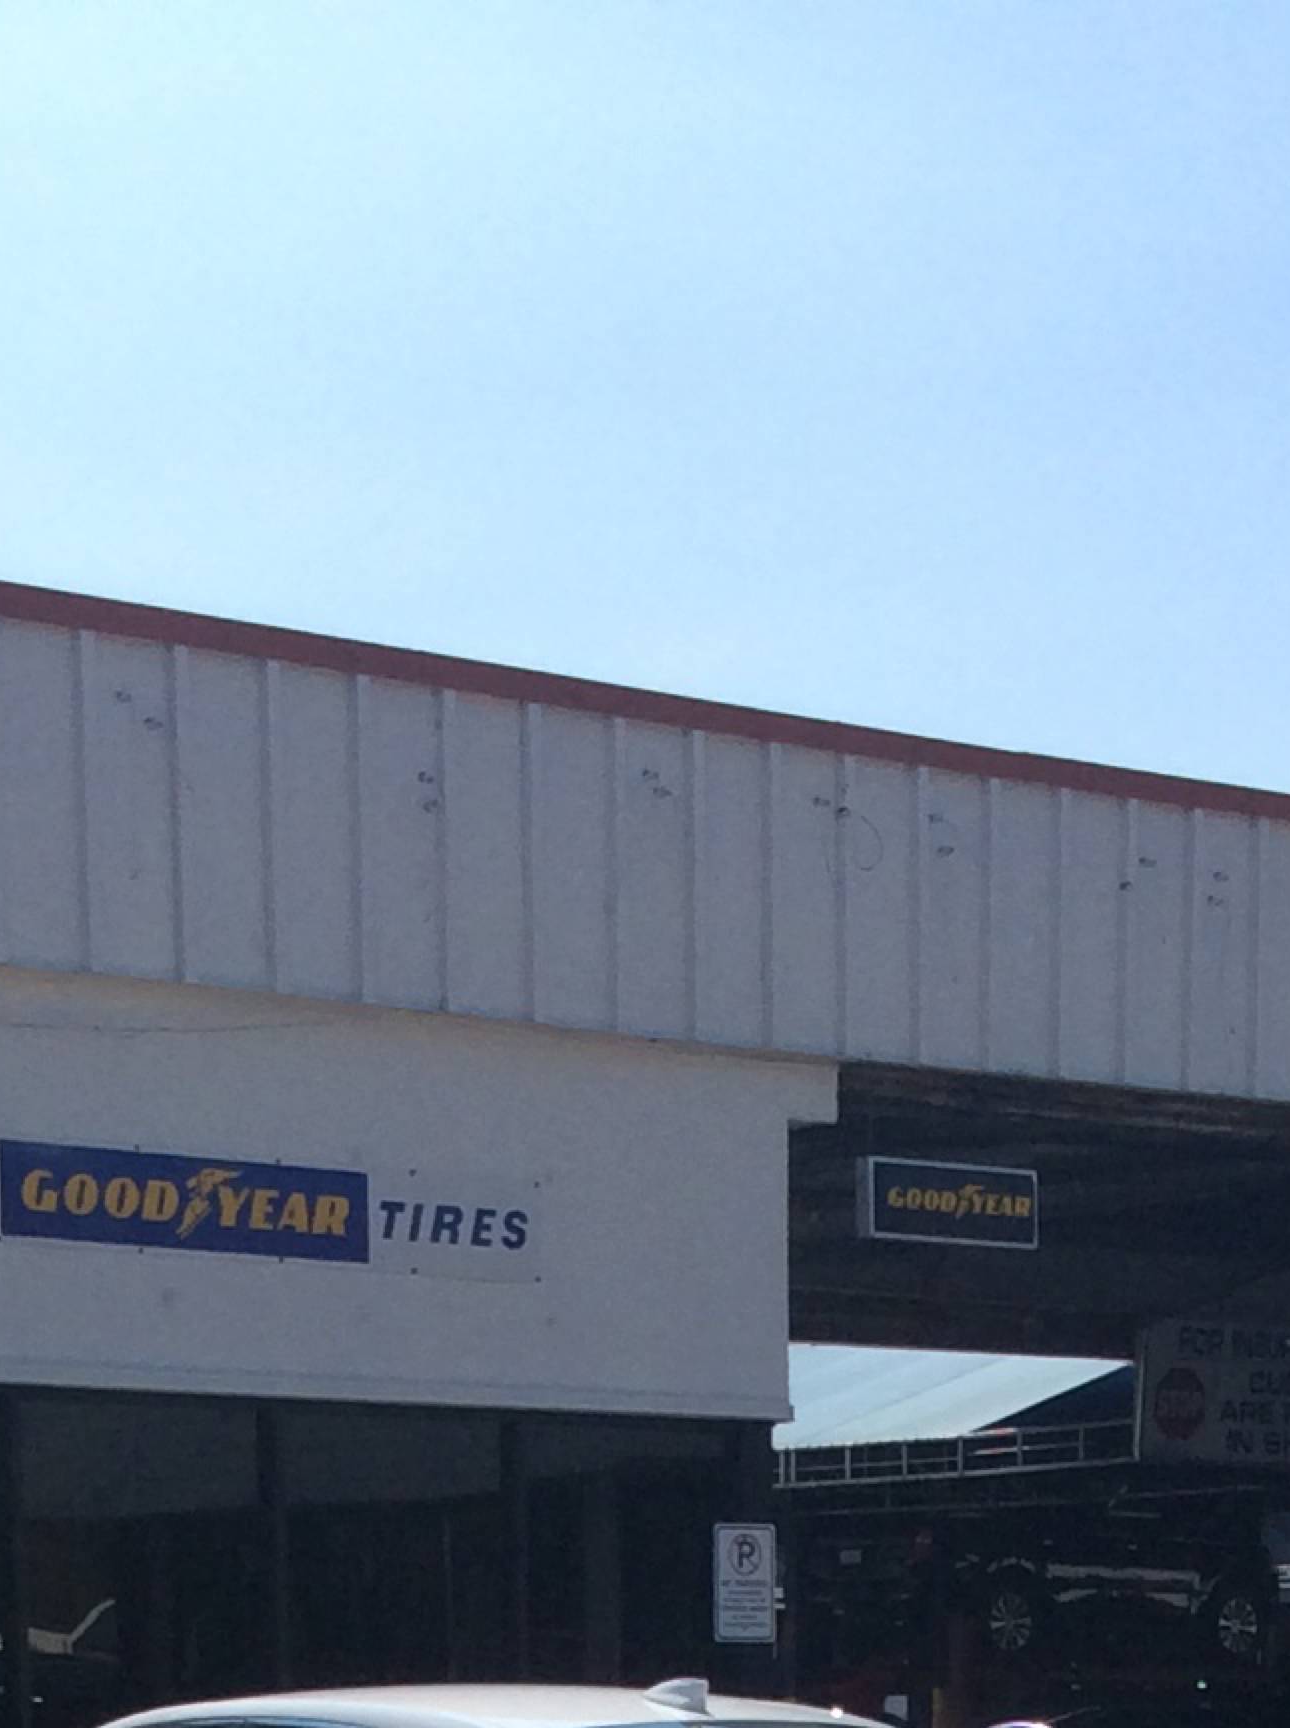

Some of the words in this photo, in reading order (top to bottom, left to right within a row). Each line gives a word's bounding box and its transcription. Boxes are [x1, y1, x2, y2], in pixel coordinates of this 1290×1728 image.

[21, 1167, 350, 1240] GOODYEAR
[379, 1200, 529, 1250] TIRES
[887, 1184, 1031, 1219] GOODYEAR
[1219, 1399, 1275, 1425] ARE
[1225, 1430, 1254, 1454] IN
